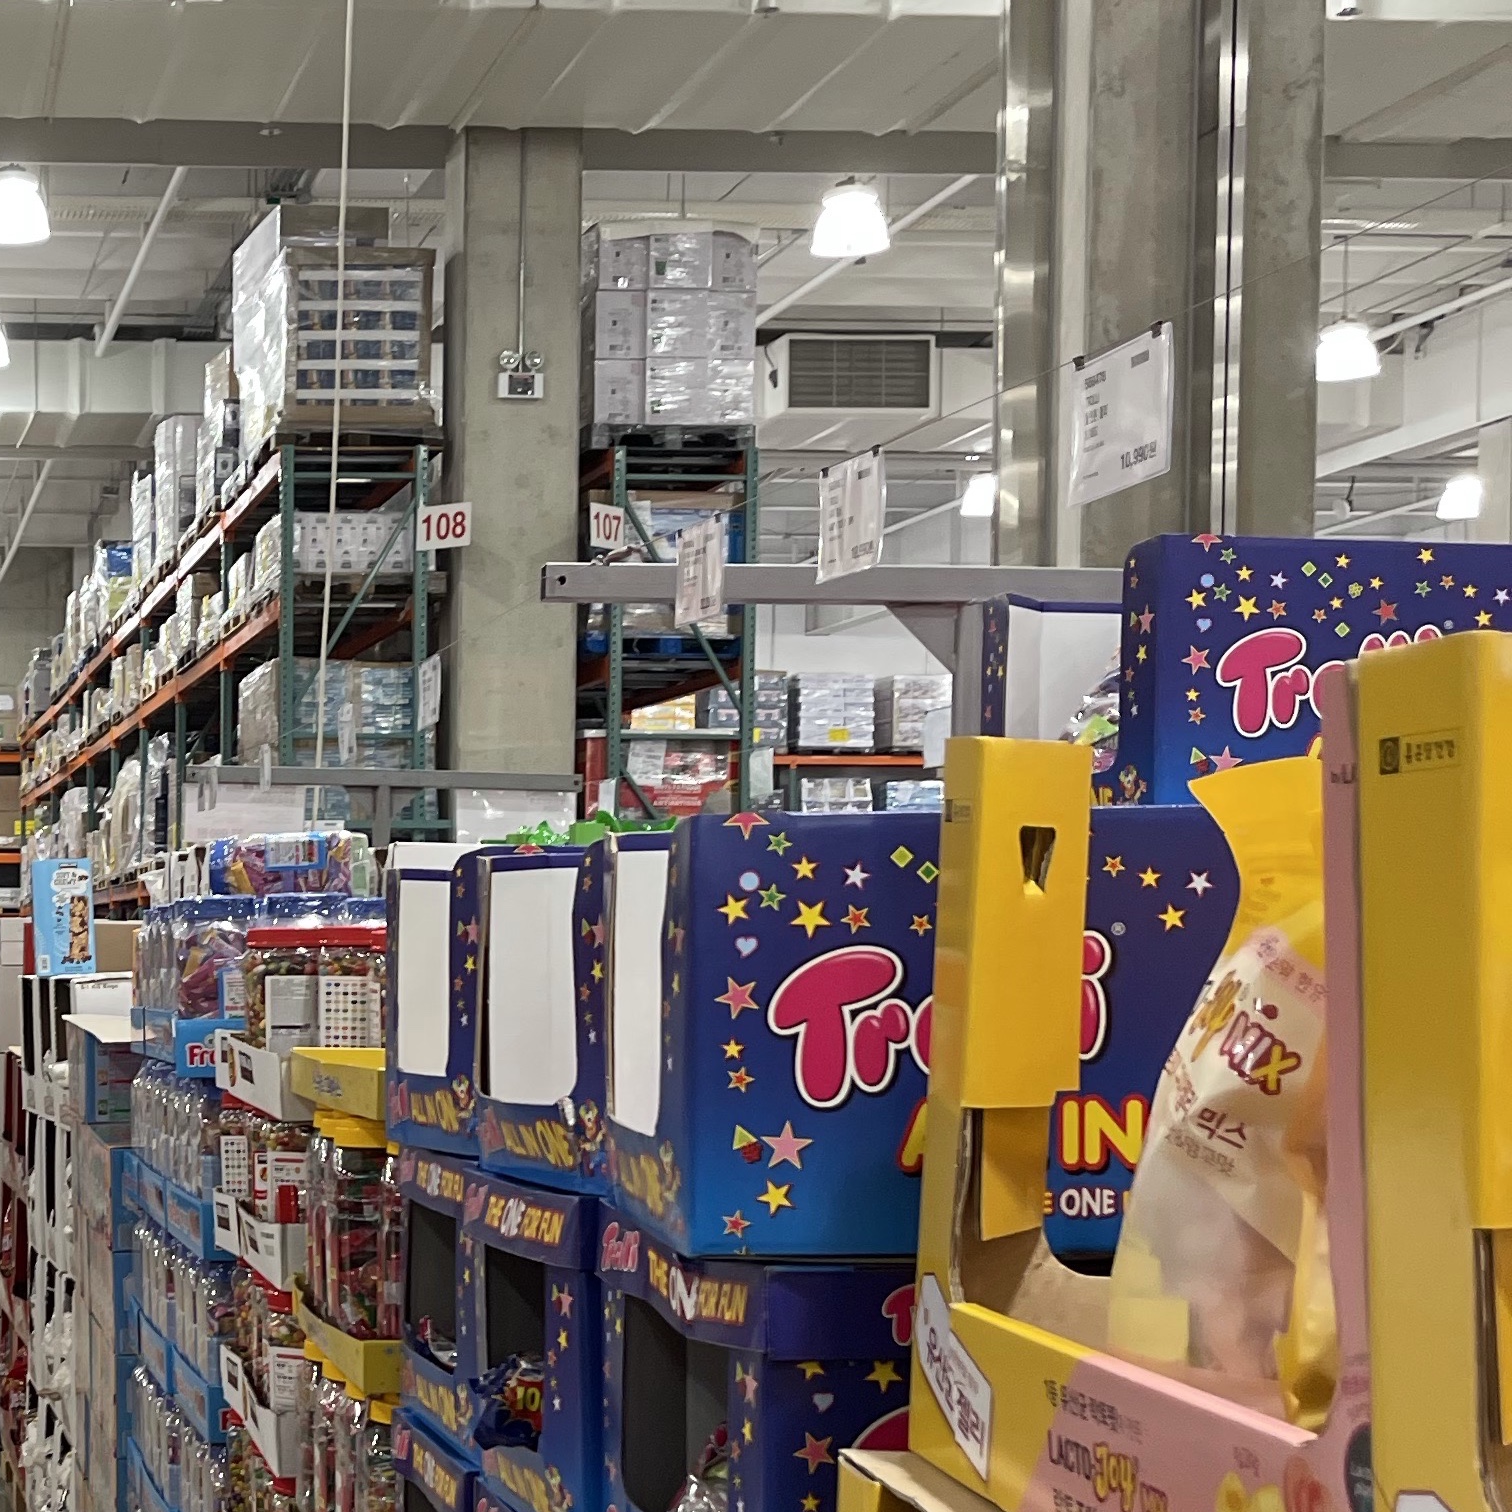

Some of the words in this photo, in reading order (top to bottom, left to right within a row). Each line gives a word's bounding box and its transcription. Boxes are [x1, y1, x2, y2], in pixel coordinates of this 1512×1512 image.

[420, 511, 468, 542] 108
[591, 511, 623, 542] 107
[1219, 1010, 1302, 1096] MIX
[1058, 1094, 1150, 1172] IN
[500, 1198, 527, 1238] ONE
[538, 1210, 565, 1247] FUN
[1059, 1187, 1116, 1217] ONE
[647, 1248, 670, 1298] THE
